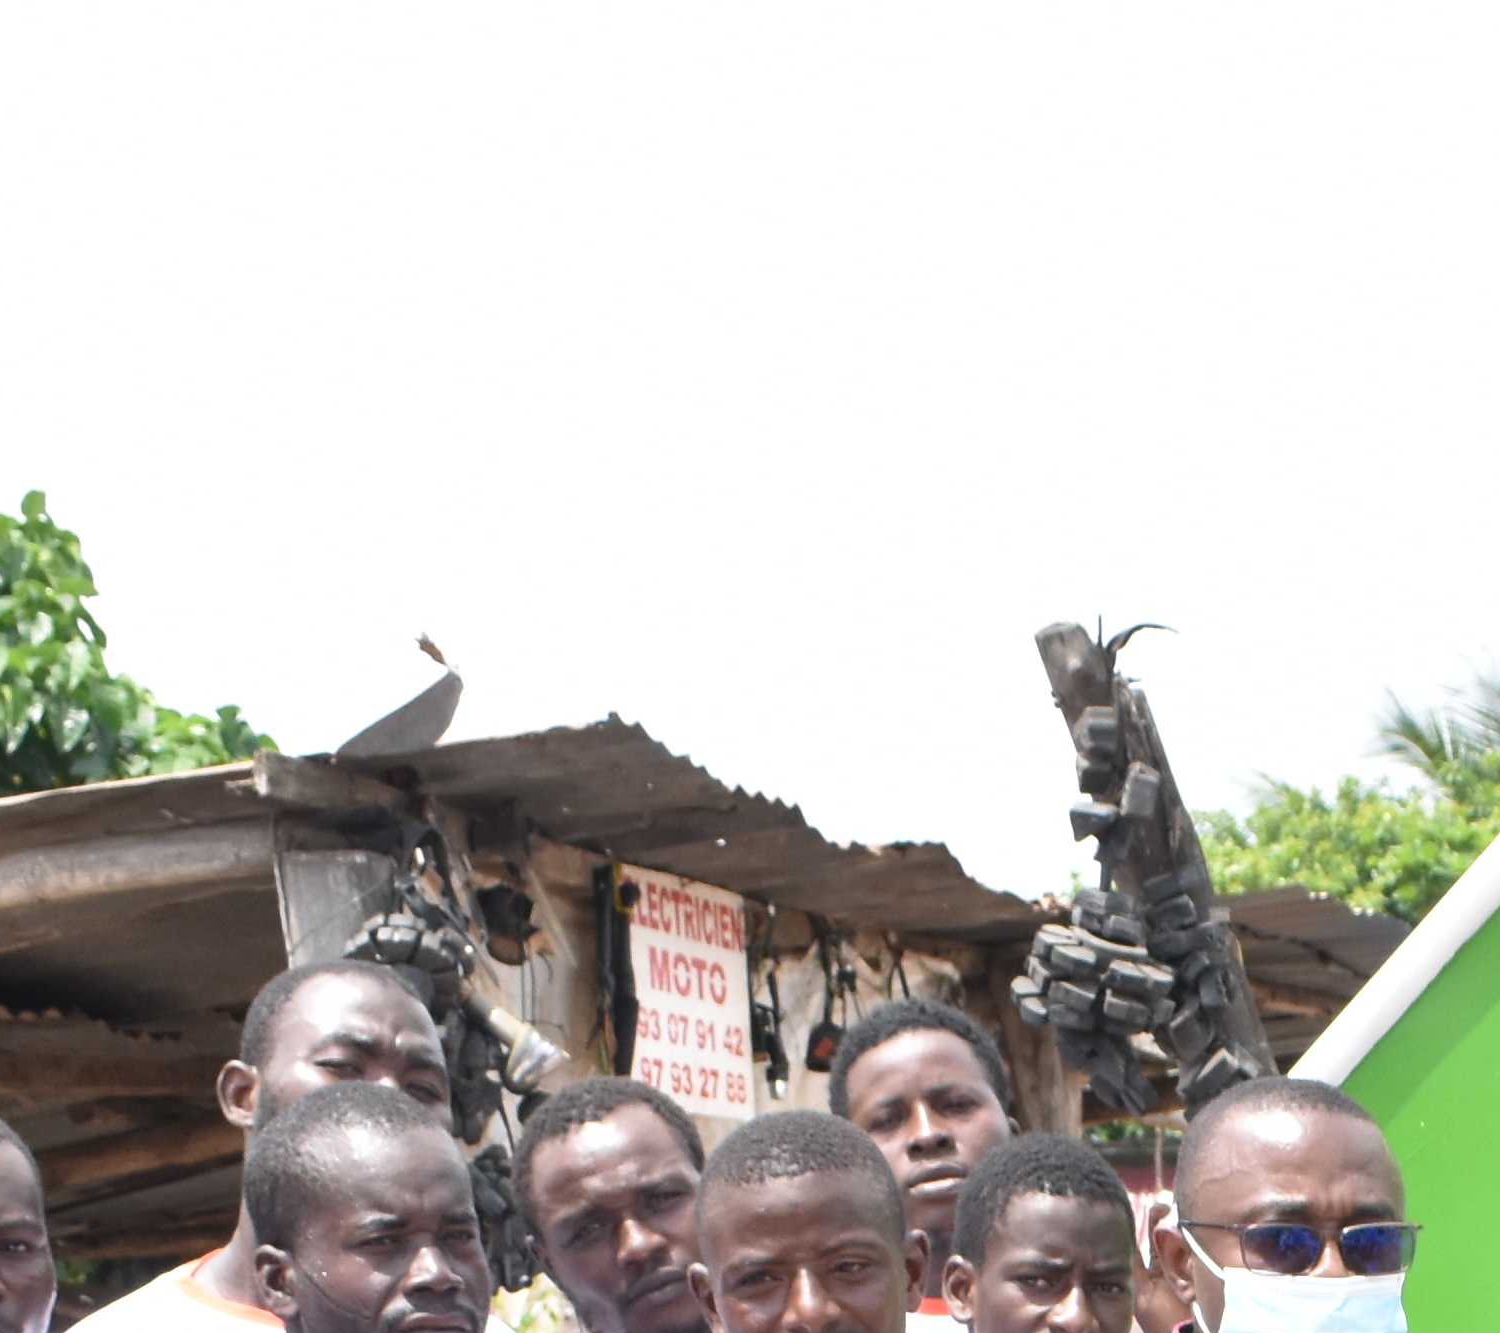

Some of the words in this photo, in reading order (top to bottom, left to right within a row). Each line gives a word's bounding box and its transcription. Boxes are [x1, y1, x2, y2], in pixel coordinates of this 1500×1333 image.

[648, 946, 727, 1005] MOTO
[637, 1006, 660, 1040] 93
[668, 1013, 689, 1045] 07
[696, 1018, 716, 1052] 91
[723, 1025, 744, 1056] 42
[641, 1057, 663, 1089] 97
[670, 1061, 693, 1095] 93
[700, 1067, 719, 1099] 27
